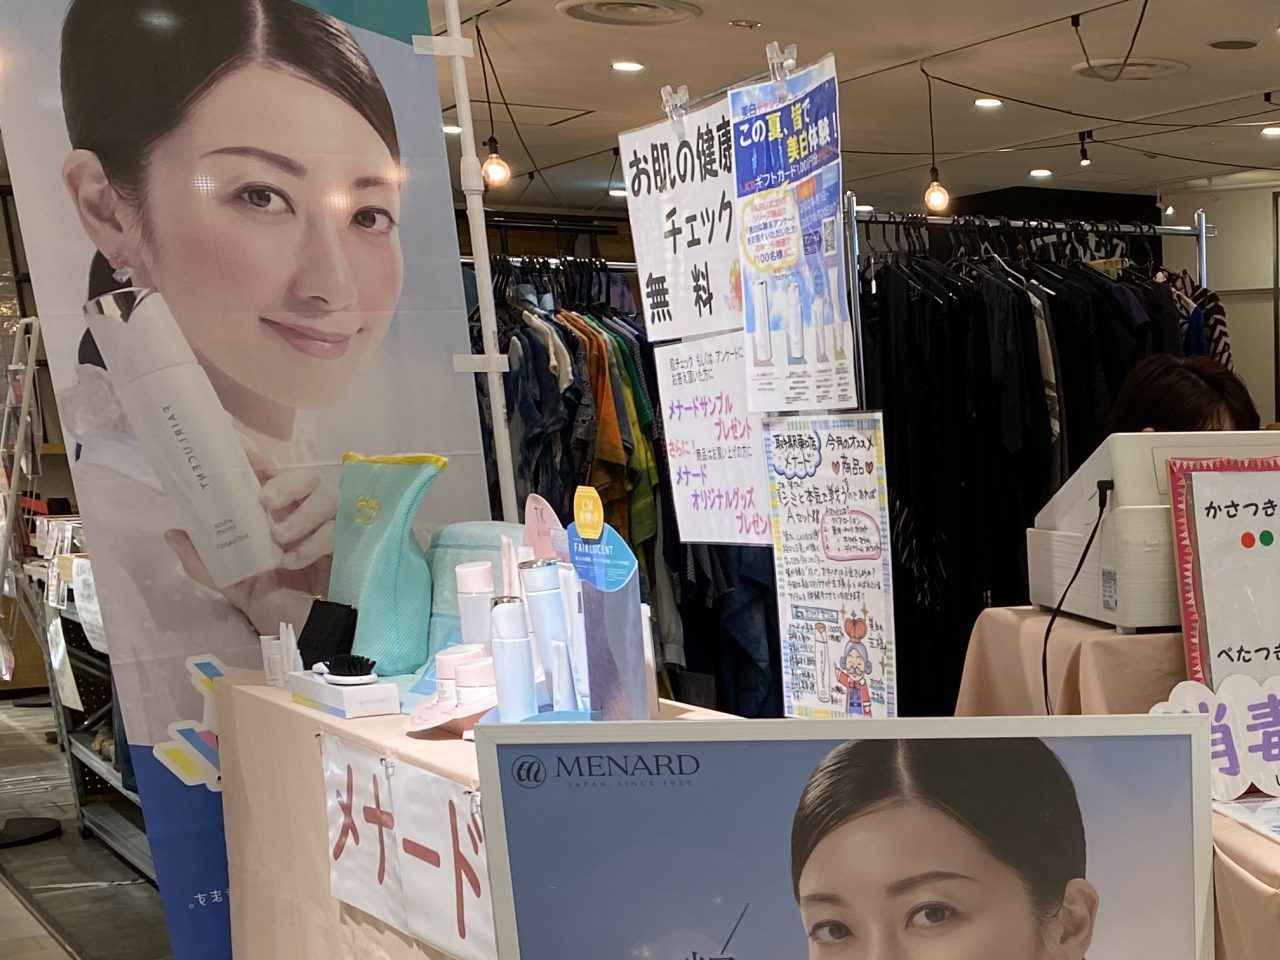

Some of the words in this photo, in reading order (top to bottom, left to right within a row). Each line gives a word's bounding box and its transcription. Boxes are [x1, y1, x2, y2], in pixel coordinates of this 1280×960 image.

[628, 115, 732, 197] お肌の健康
[664, 190, 733, 255] チェック
[669, 391, 733, 421] メナードサンプル
[714, 416, 752, 441] プレゼント
[676, 463, 708, 486] メナード
[840, 453, 865, 476] 商品
[692, 487, 756, 511] オリジナルグッズ
[1203, 499, 1279, 520] かさつき
[555, 754, 700, 778] MENARD
[333, 763, 483, 940] メナード
